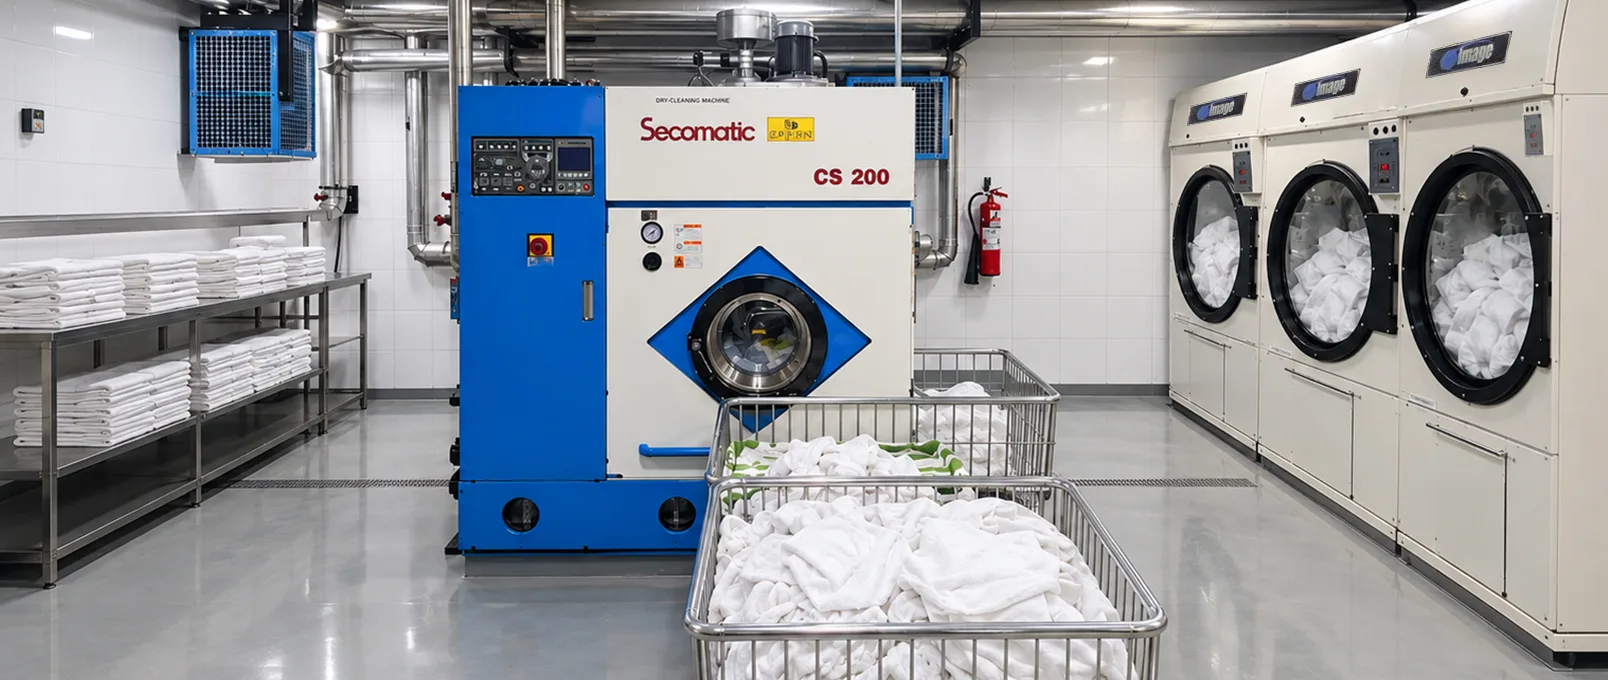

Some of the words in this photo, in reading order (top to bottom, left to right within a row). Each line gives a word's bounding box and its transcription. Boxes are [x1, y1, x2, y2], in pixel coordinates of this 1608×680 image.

[1457, 43, 1494, 65] Image
[1316, 78, 1346, 96] Image
[1209, 100, 1235, 117] Image
[640, 116, 755, 142] Secomatic
[813, 169, 842, 186] CS
[851, 169, 890, 186] 200
